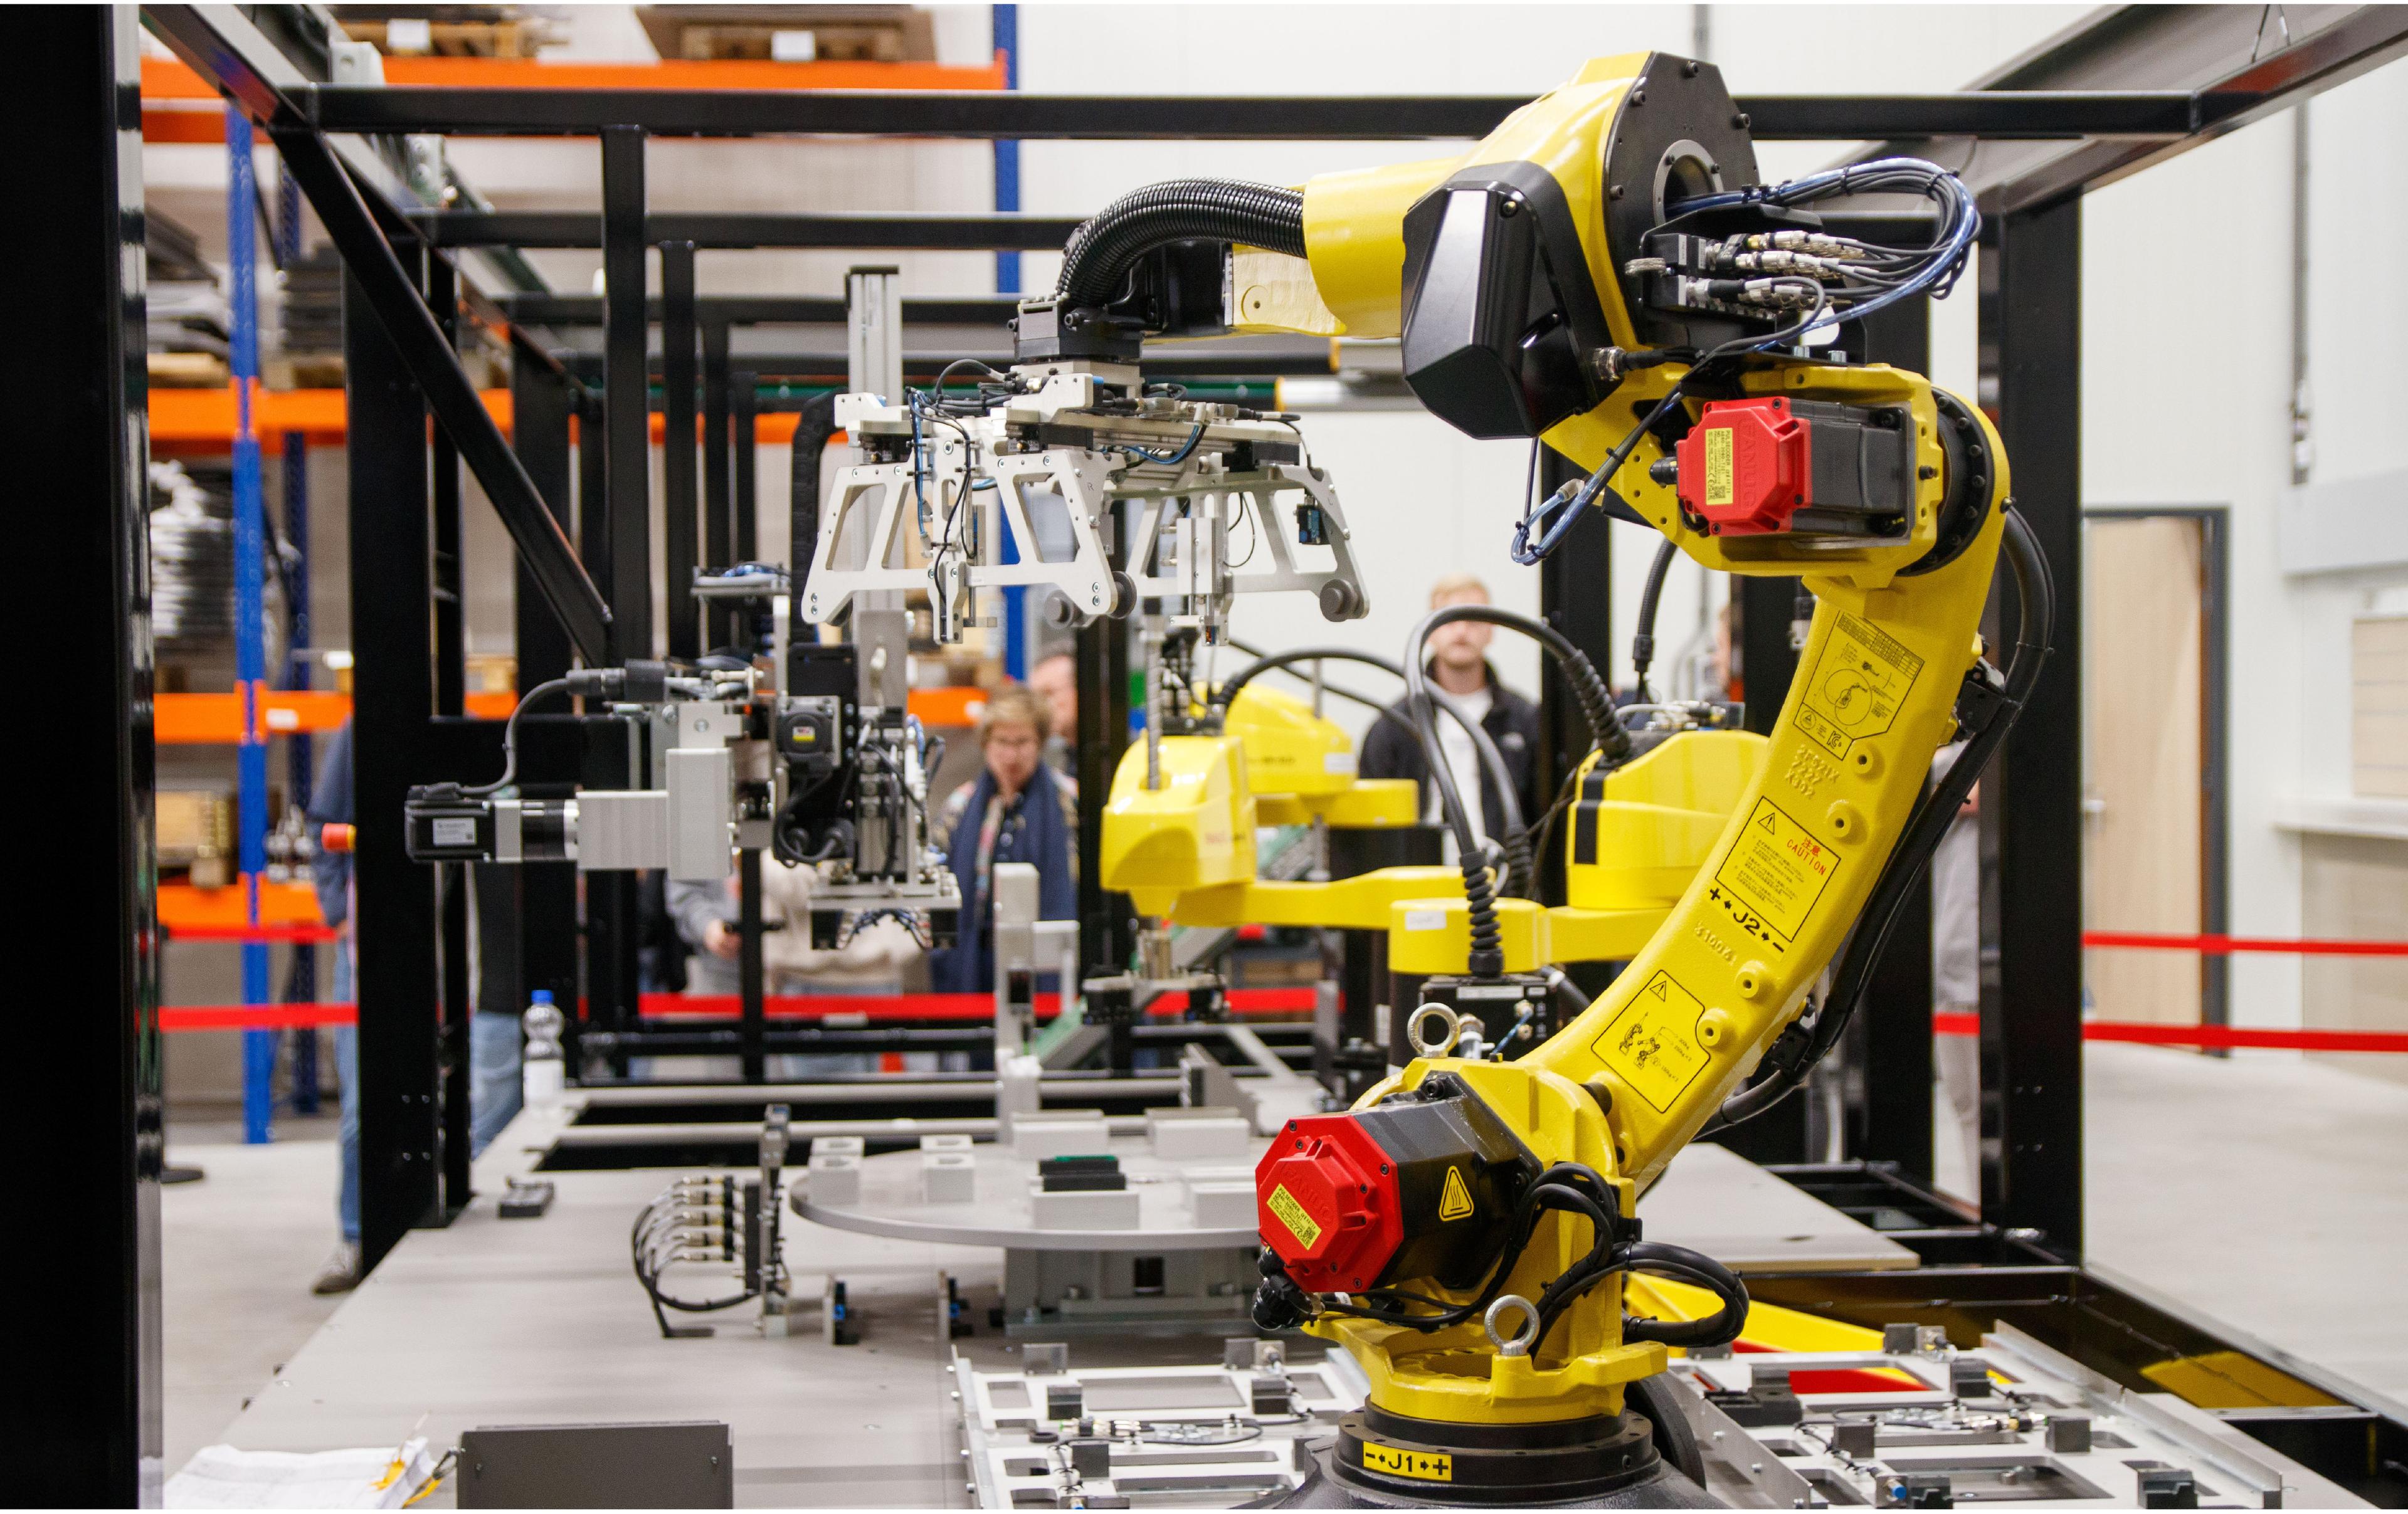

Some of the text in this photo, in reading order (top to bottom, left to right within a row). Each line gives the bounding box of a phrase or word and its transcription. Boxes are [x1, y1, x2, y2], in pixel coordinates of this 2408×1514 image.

[1087, 482, 1094, 492] R
[1787, 839, 1827, 876] CAUTION
[1733, 912, 1760, 936] J2
[1388, 1454, 1413, 1472] J1
